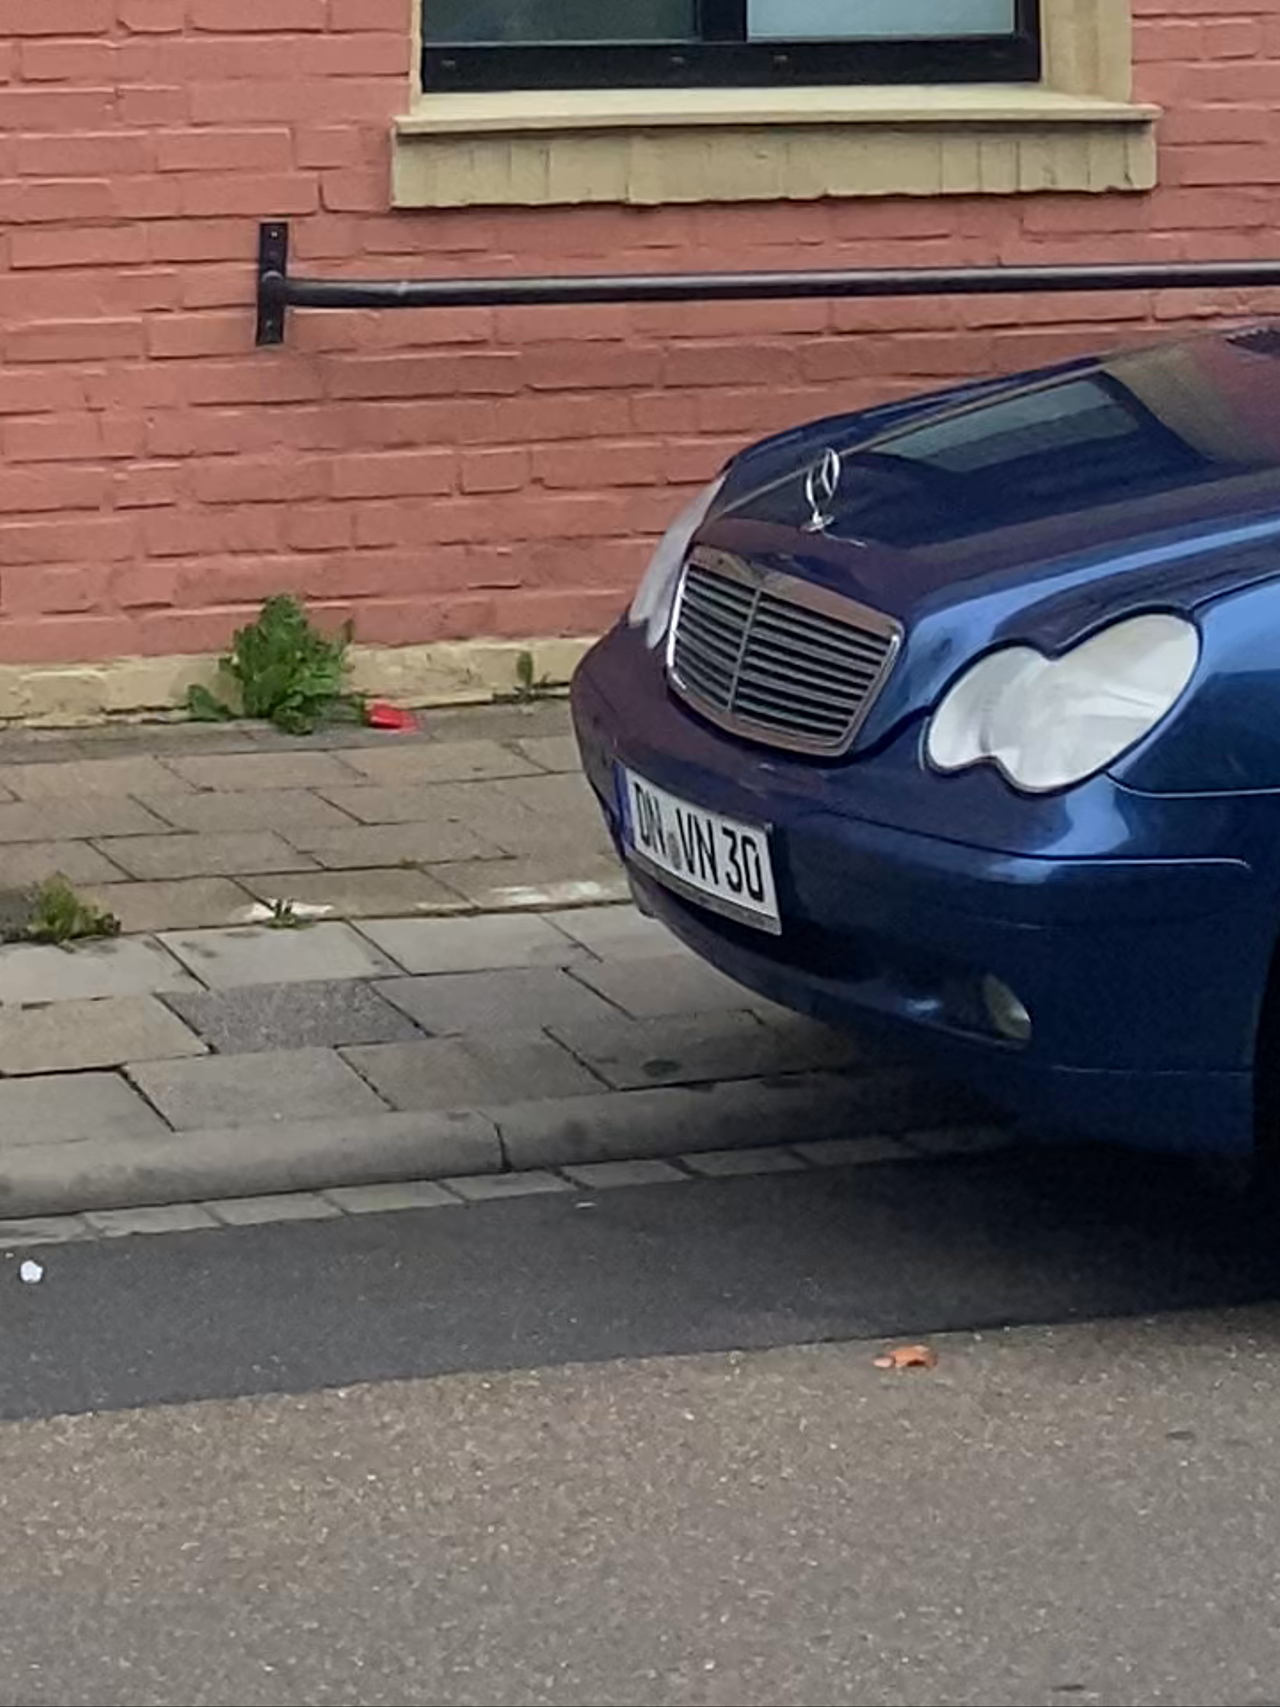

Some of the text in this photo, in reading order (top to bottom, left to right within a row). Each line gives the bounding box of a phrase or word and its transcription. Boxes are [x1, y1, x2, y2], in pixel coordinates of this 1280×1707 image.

[634, 781, 765, 903] DN VN 30
